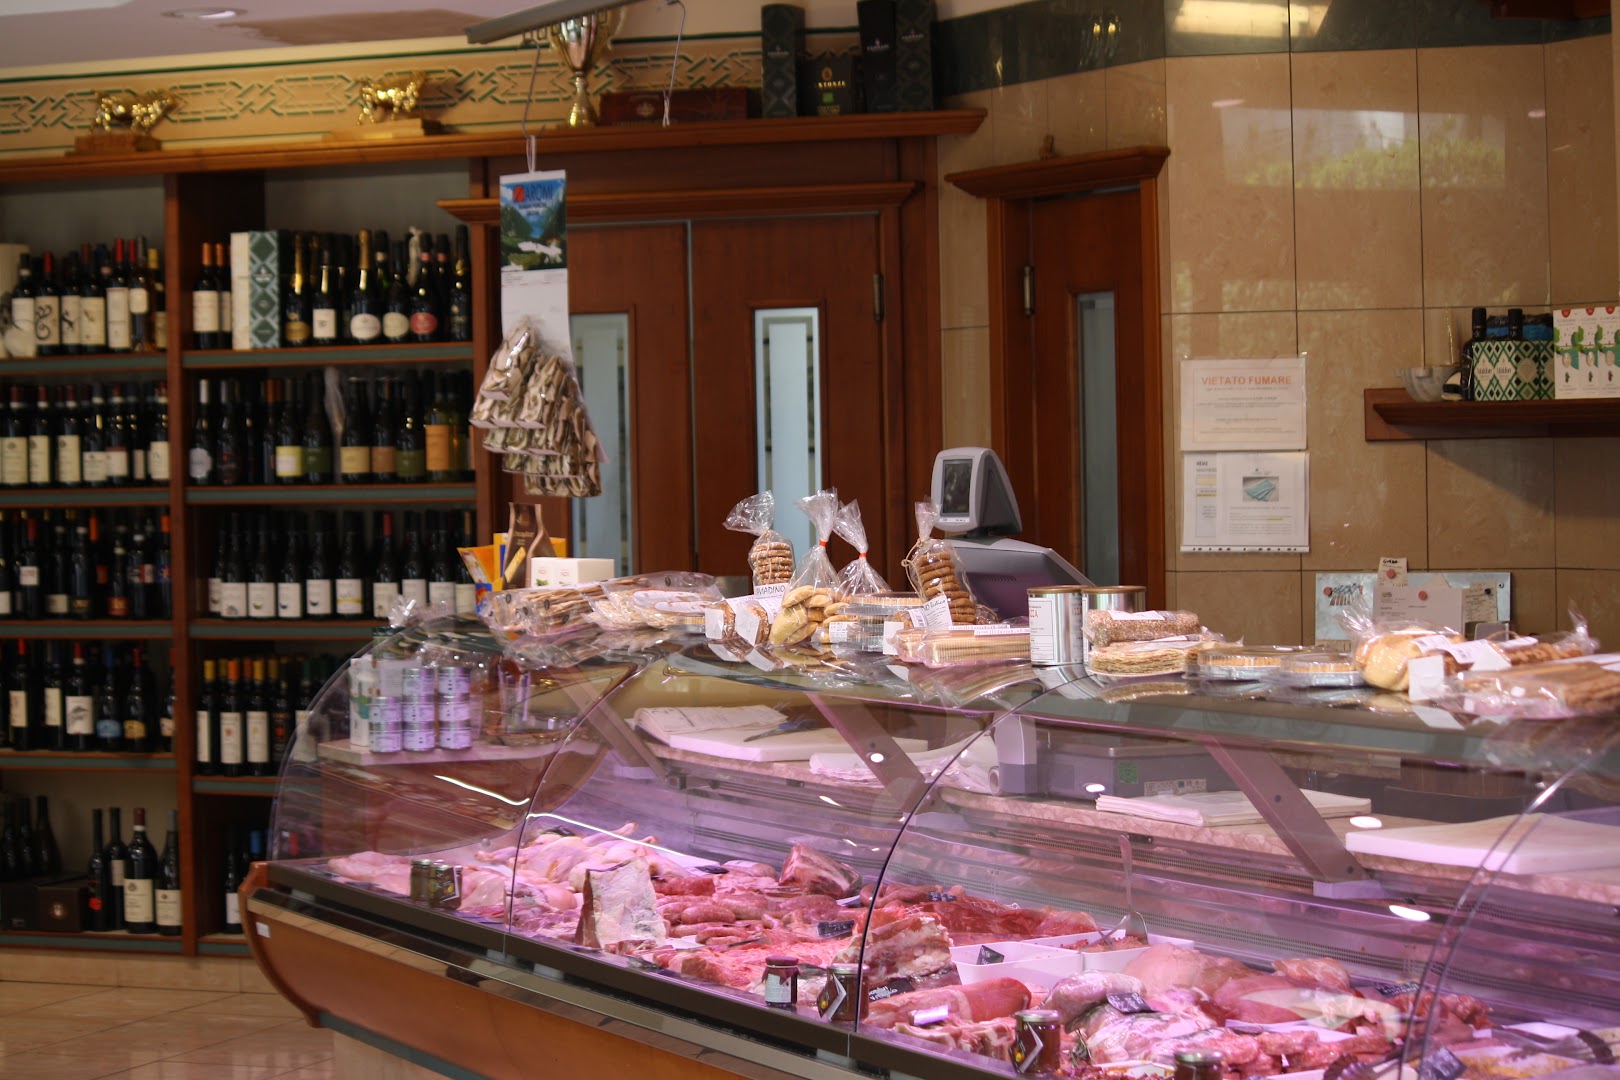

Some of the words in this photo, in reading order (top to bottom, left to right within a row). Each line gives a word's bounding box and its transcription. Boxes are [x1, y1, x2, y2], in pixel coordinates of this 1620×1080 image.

[525, 183, 553, 202] AROMI
[1201, 376, 1245, 385] VIETATO
[1248, 375, 1292, 385] FUMARE
